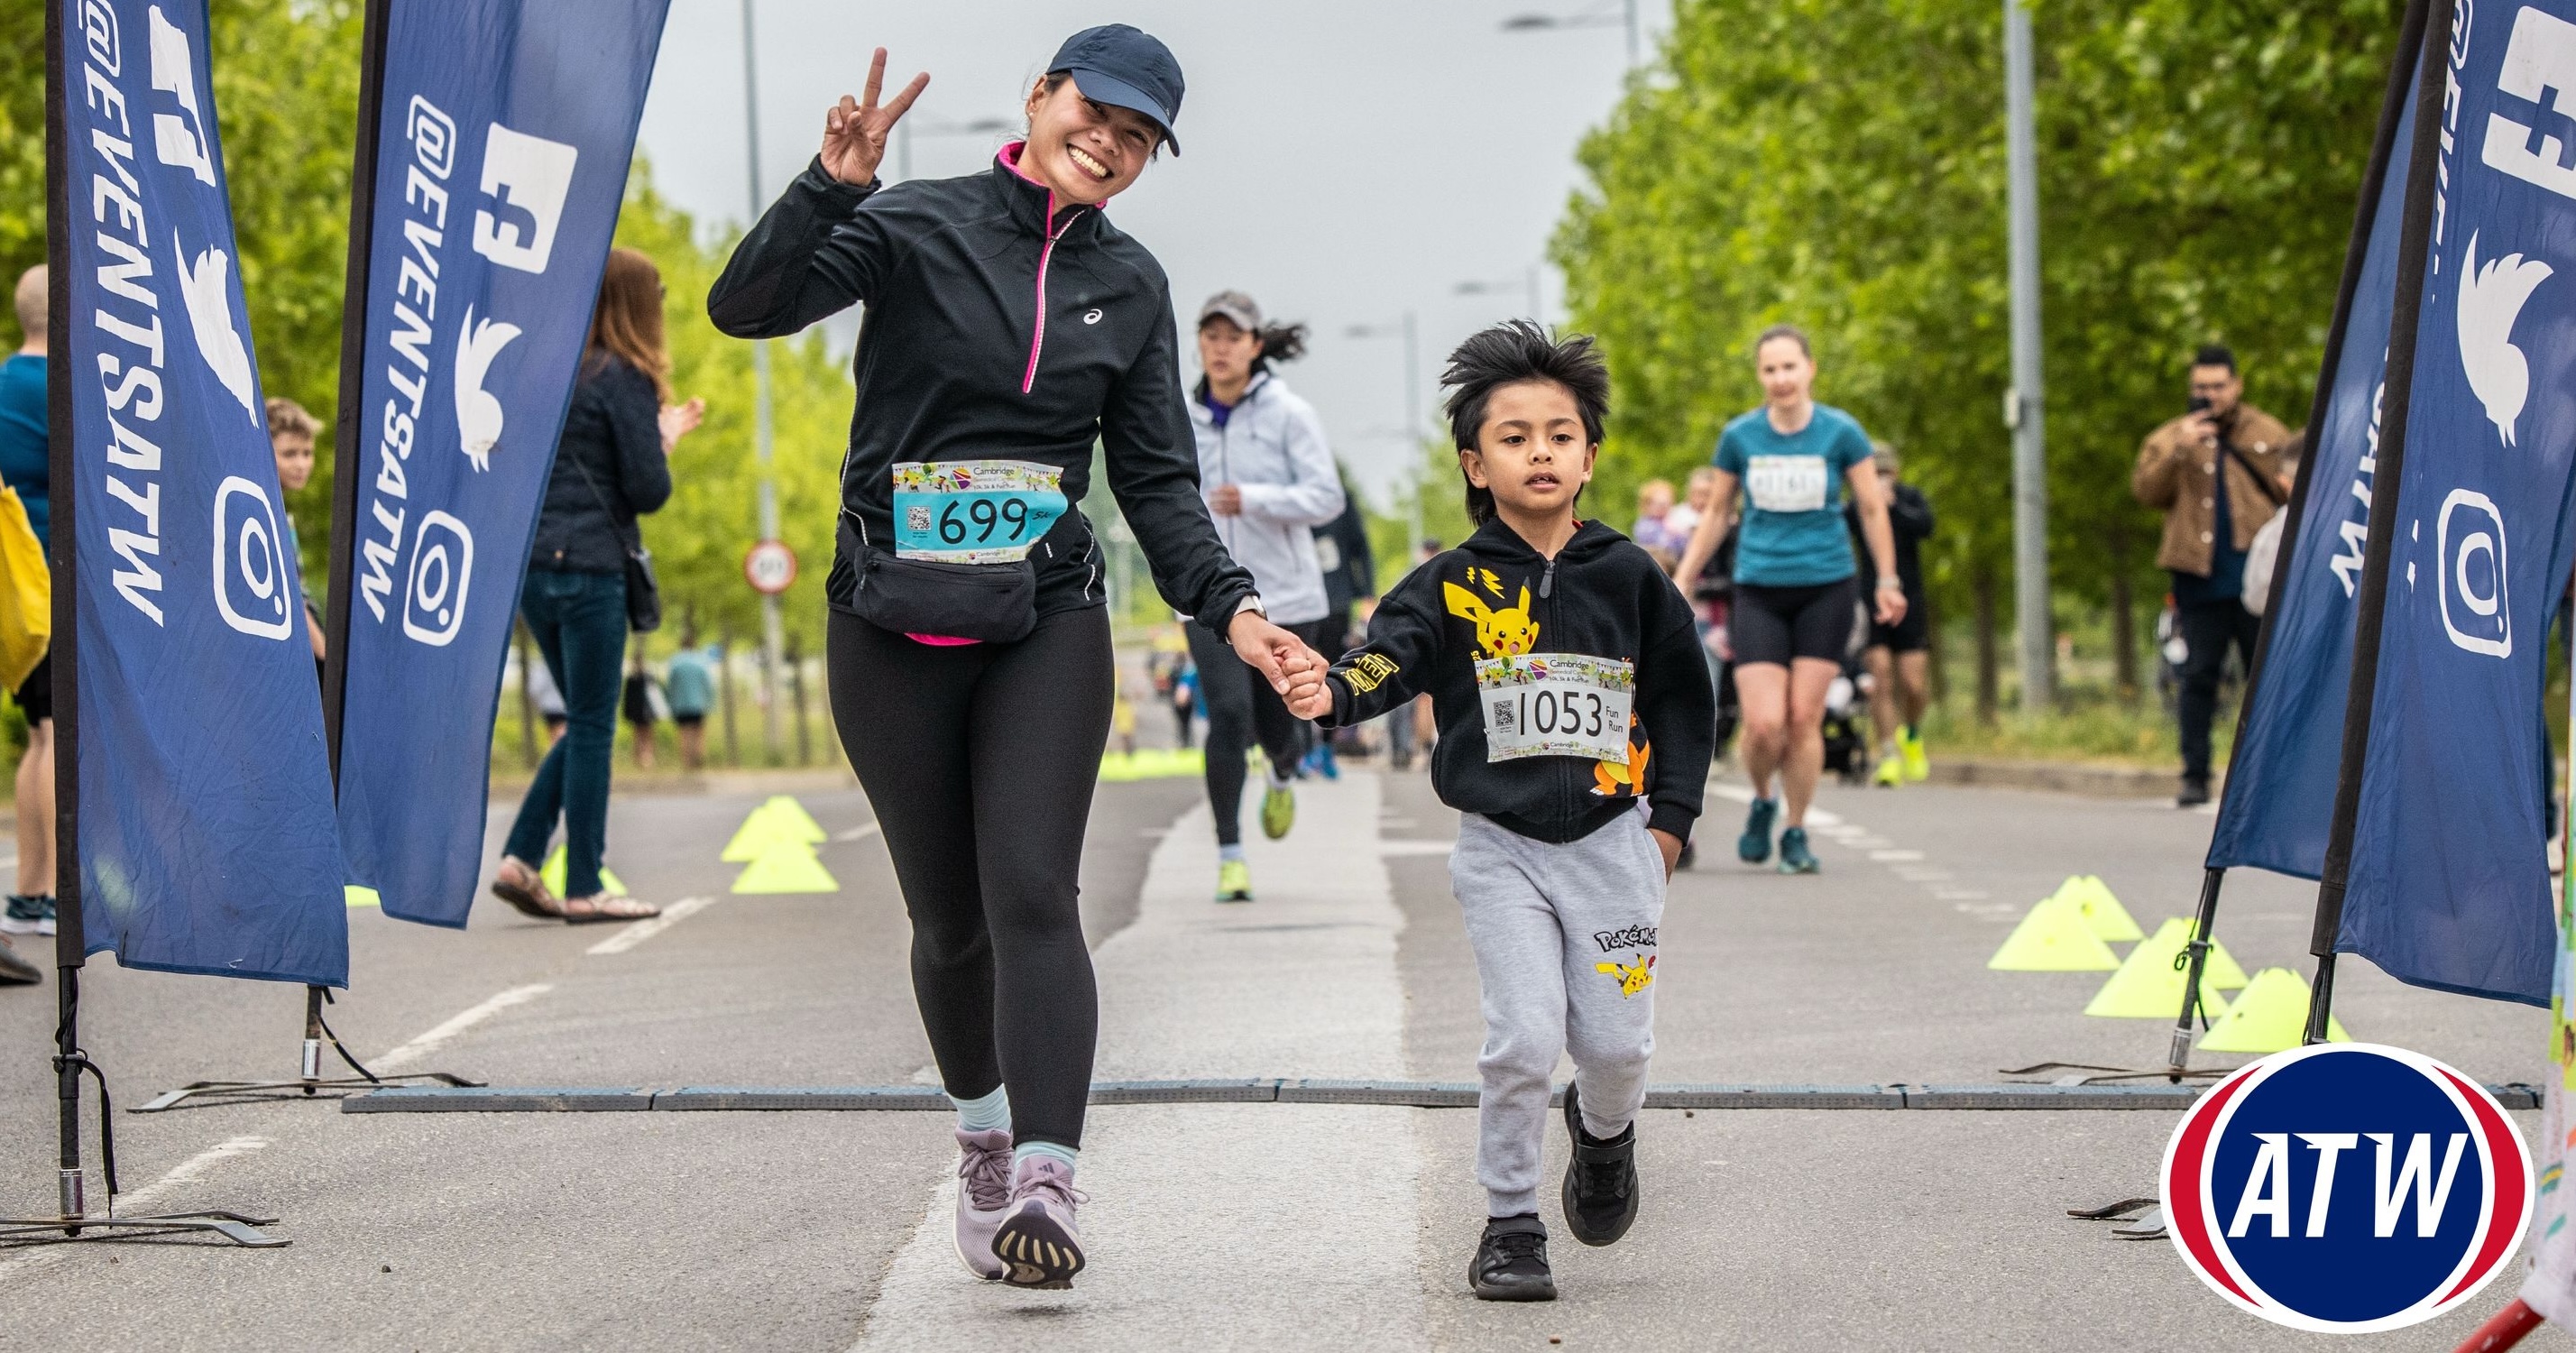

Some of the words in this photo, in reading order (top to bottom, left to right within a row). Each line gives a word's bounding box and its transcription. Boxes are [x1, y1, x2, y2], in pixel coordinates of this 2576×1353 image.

[78, 0, 164, 627] @EVENTSATW
[359, 95, 456, 624] @EVENTSATW
[973, 466, 1015, 476] Cambridge
[939, 498, 1028, 545] 699
[1550, 659, 1589, 671] Cambridge
[1519, 690, 1602, 737] 1053
[1605, 706, 1619, 719] Fun
[1608, 720, 1624, 733] Run
